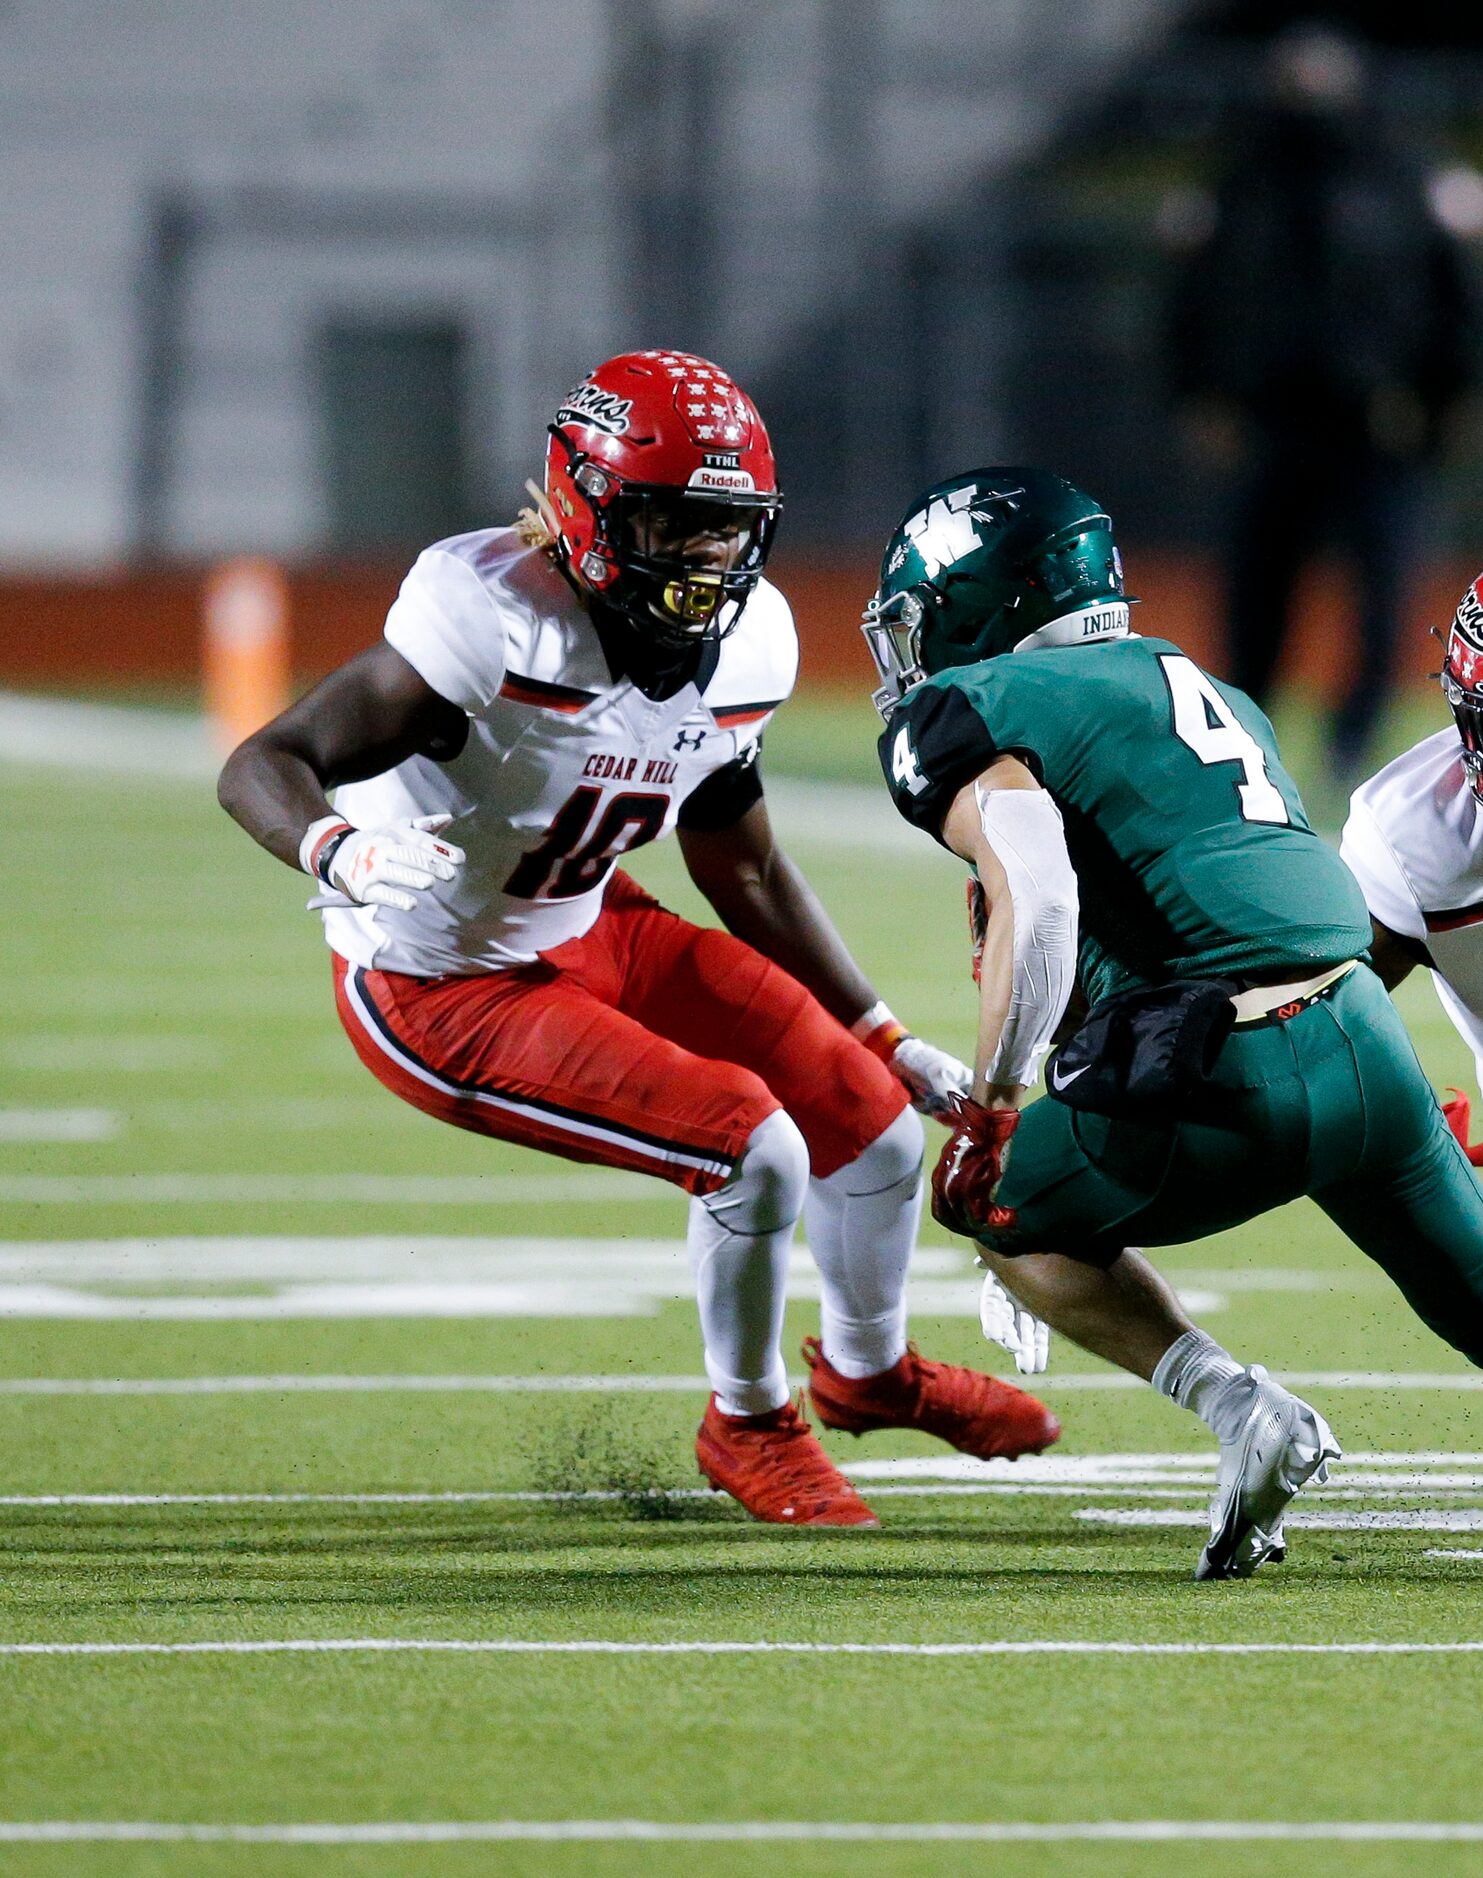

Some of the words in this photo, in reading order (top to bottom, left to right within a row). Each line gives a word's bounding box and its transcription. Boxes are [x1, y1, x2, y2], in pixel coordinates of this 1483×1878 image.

[701, 473, 749, 488] Riddell
[704, 453, 740, 468] TTHL
[891, 723, 933, 797] 4
[1156, 652, 1290, 825] 4
[582, 754, 639, 782] CEDAR
[641, 758, 679, 784] HILL
[502, 784, 671, 899] 10
